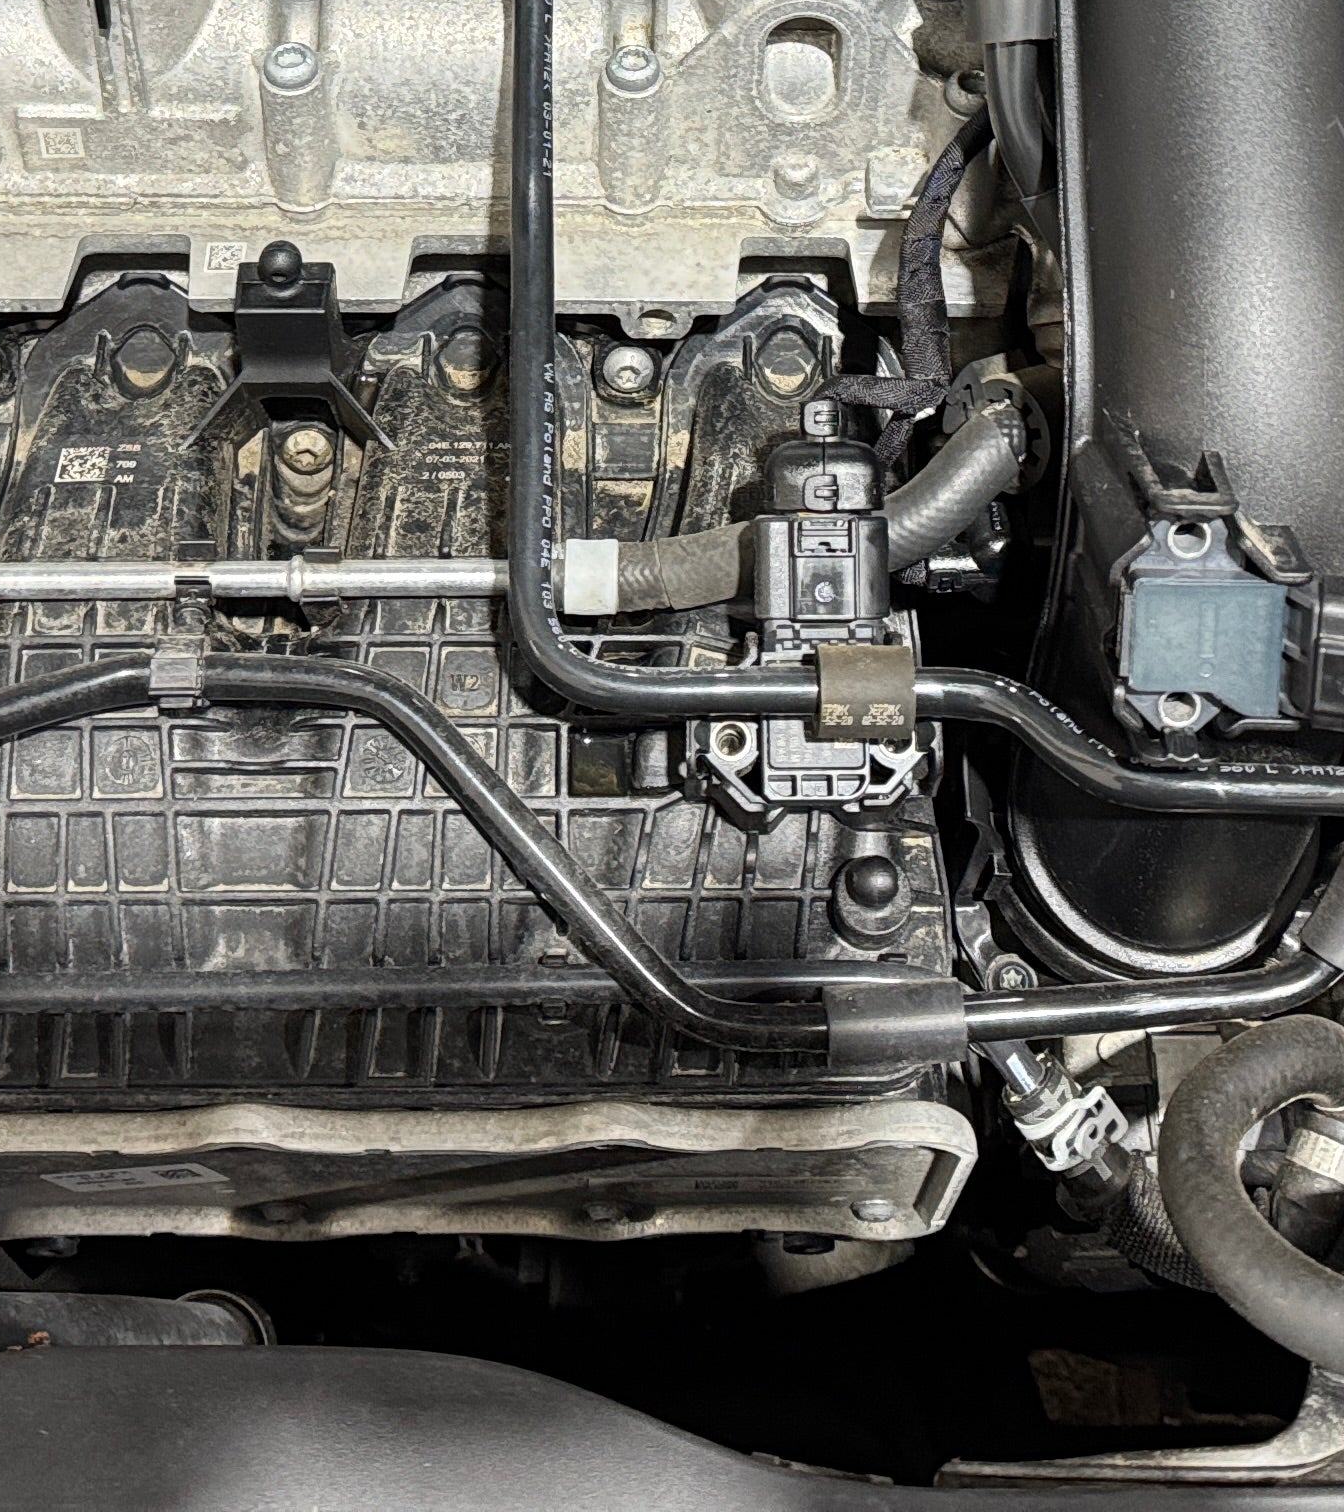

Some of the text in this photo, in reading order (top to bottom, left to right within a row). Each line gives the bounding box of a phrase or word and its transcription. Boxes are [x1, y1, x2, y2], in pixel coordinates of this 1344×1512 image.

[542, 362, 553, 383] VW
[542, 391, 553, 414] AG
[540, 421, 555, 487] Poland
[113, 473, 135, 483] AM
[538, 538, 551, 568] 04E
[541, 580, 553, 610] 103
